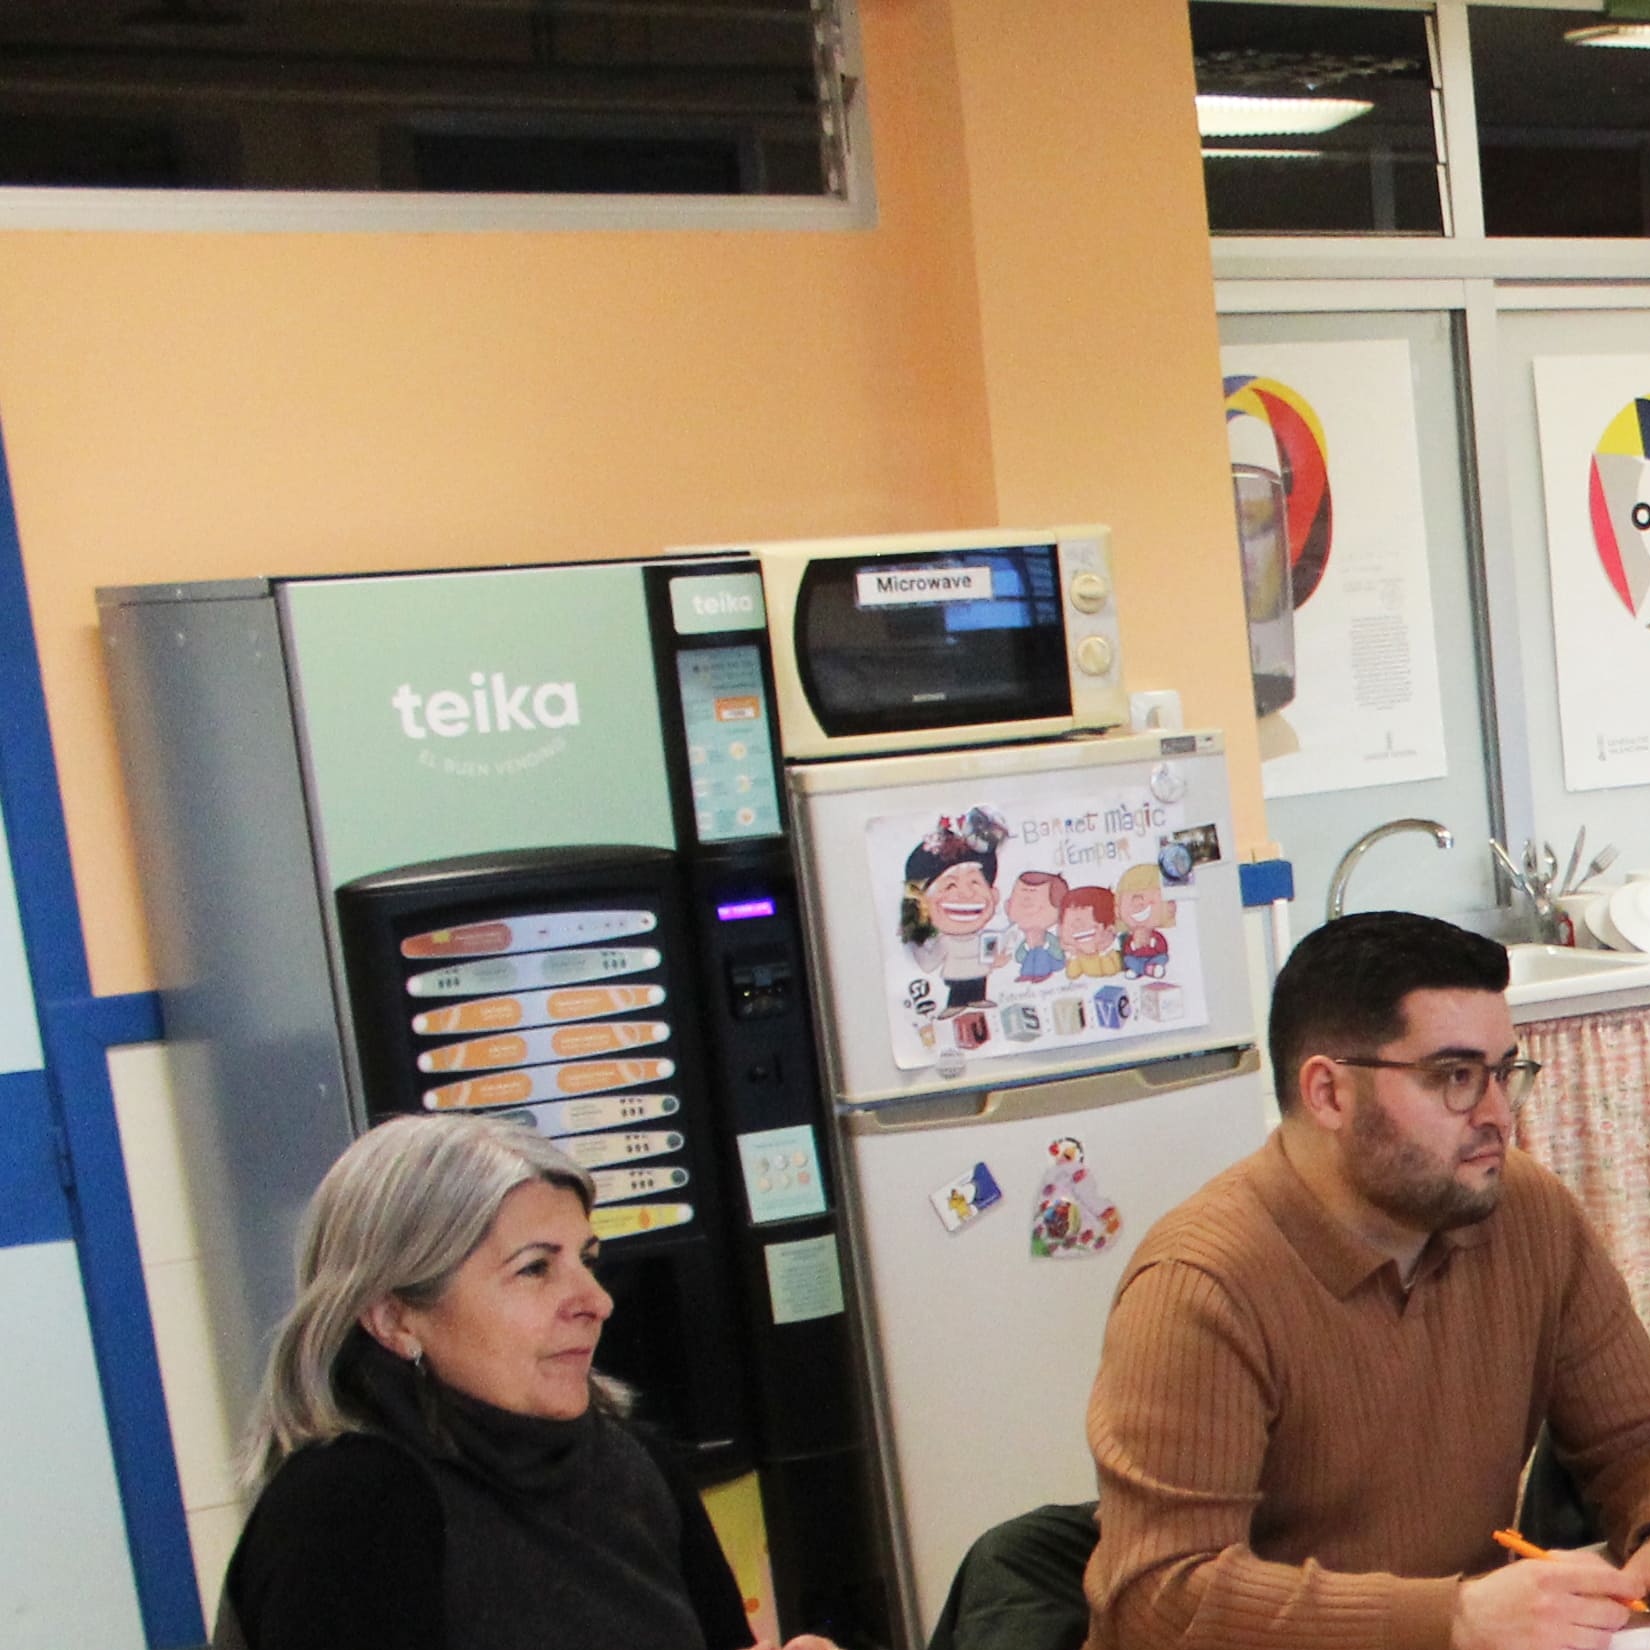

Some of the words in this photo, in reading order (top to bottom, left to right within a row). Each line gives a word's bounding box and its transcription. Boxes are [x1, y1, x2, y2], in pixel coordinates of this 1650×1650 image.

[876, 575, 972, 593] Microwave
[693, 591, 755, 616] teika
[392, 671, 581, 739] teika
